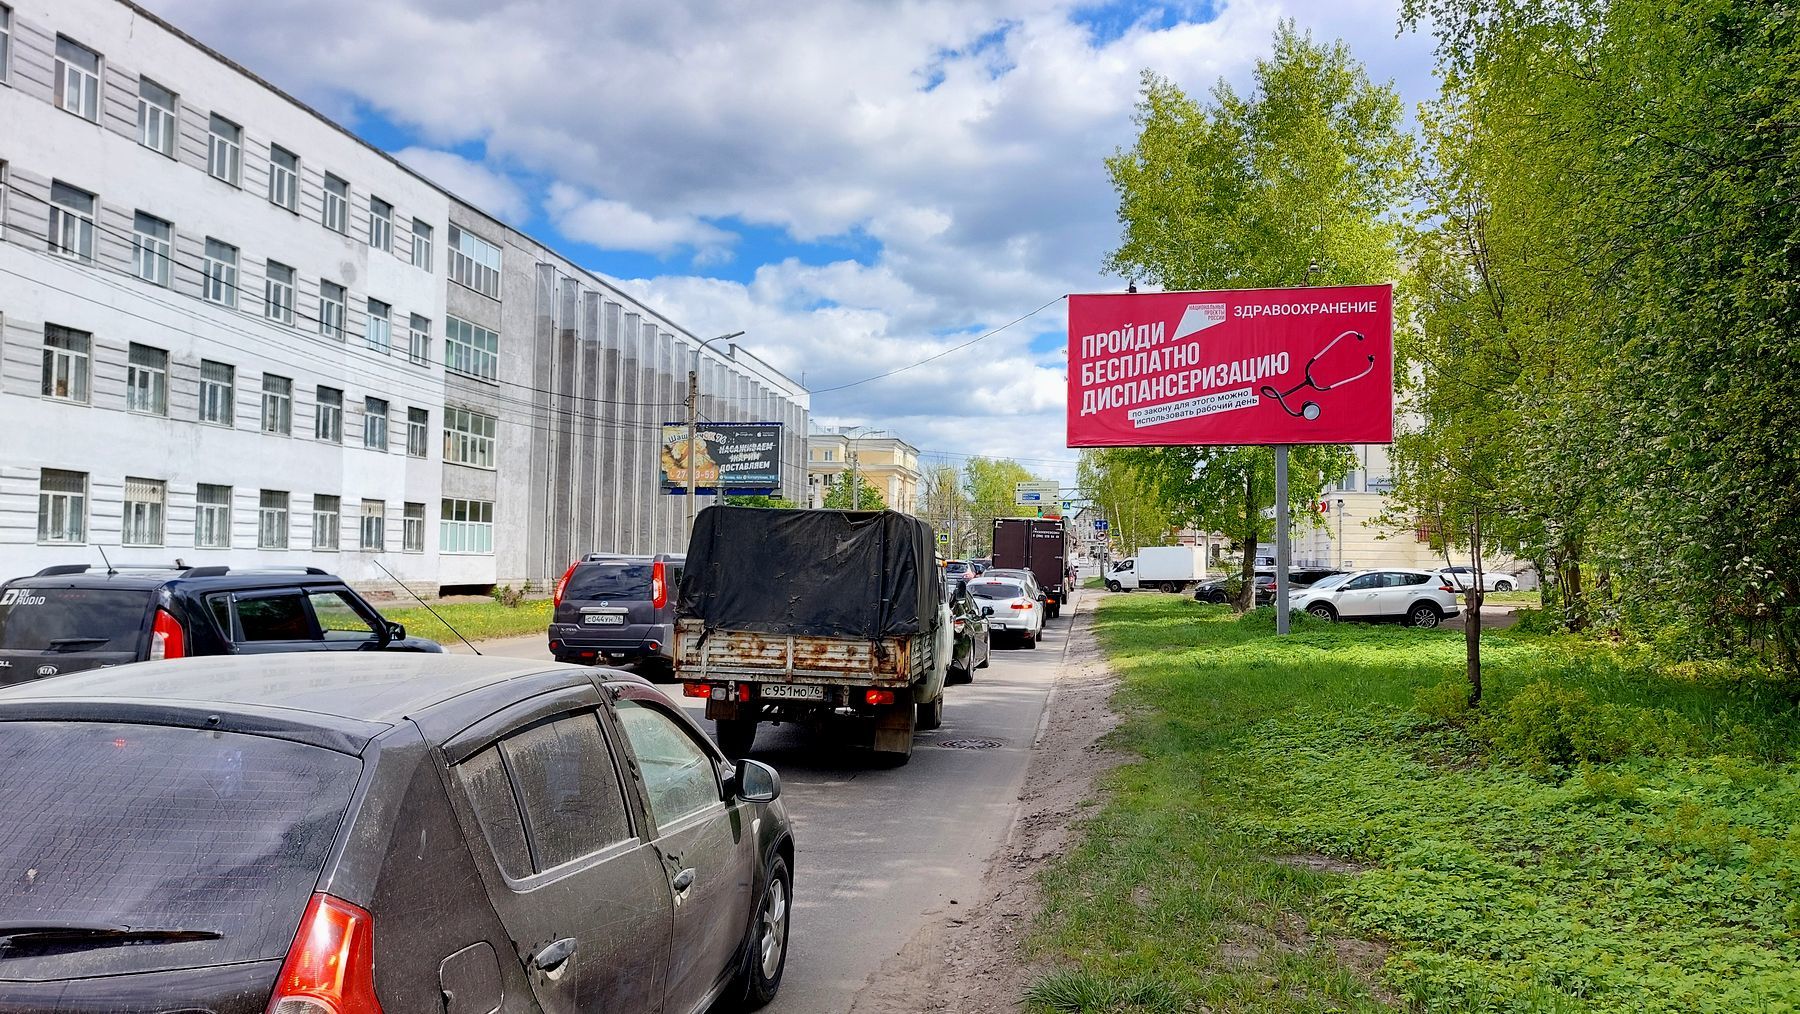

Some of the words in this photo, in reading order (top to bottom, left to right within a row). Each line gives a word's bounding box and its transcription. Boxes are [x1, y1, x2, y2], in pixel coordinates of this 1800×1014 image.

[1233, 301, 1377, 318] ЗДРАВООХРАНЕНИЕ
[1081, 321, 1165, 359] ПРОЙДИ
[1081, 342, 1200, 387] БЕСПЛАТНО
[1080, 351, 1290, 416] ДИСПАНСЕРИЗАЦИЮ
[1136, 408, 1194, 425] использовать
[1196, 401, 1233, 416] рабочий
[1234, 398, 1258, 408] день
[1144, 405, 1172, 416] закону
[1174, 402, 1190, 411] для
[1191, 396, 1216, 407] этого
[1217, 390, 1249, 401] можно
[718, 442, 774, 454] НАСАЖИВАЕМ
[719, 461, 770, 473] ДОСТАВЛЯЕМ
[16, 596, 46, 605] AUDIO
[39, 666, 54, 675] KIA
